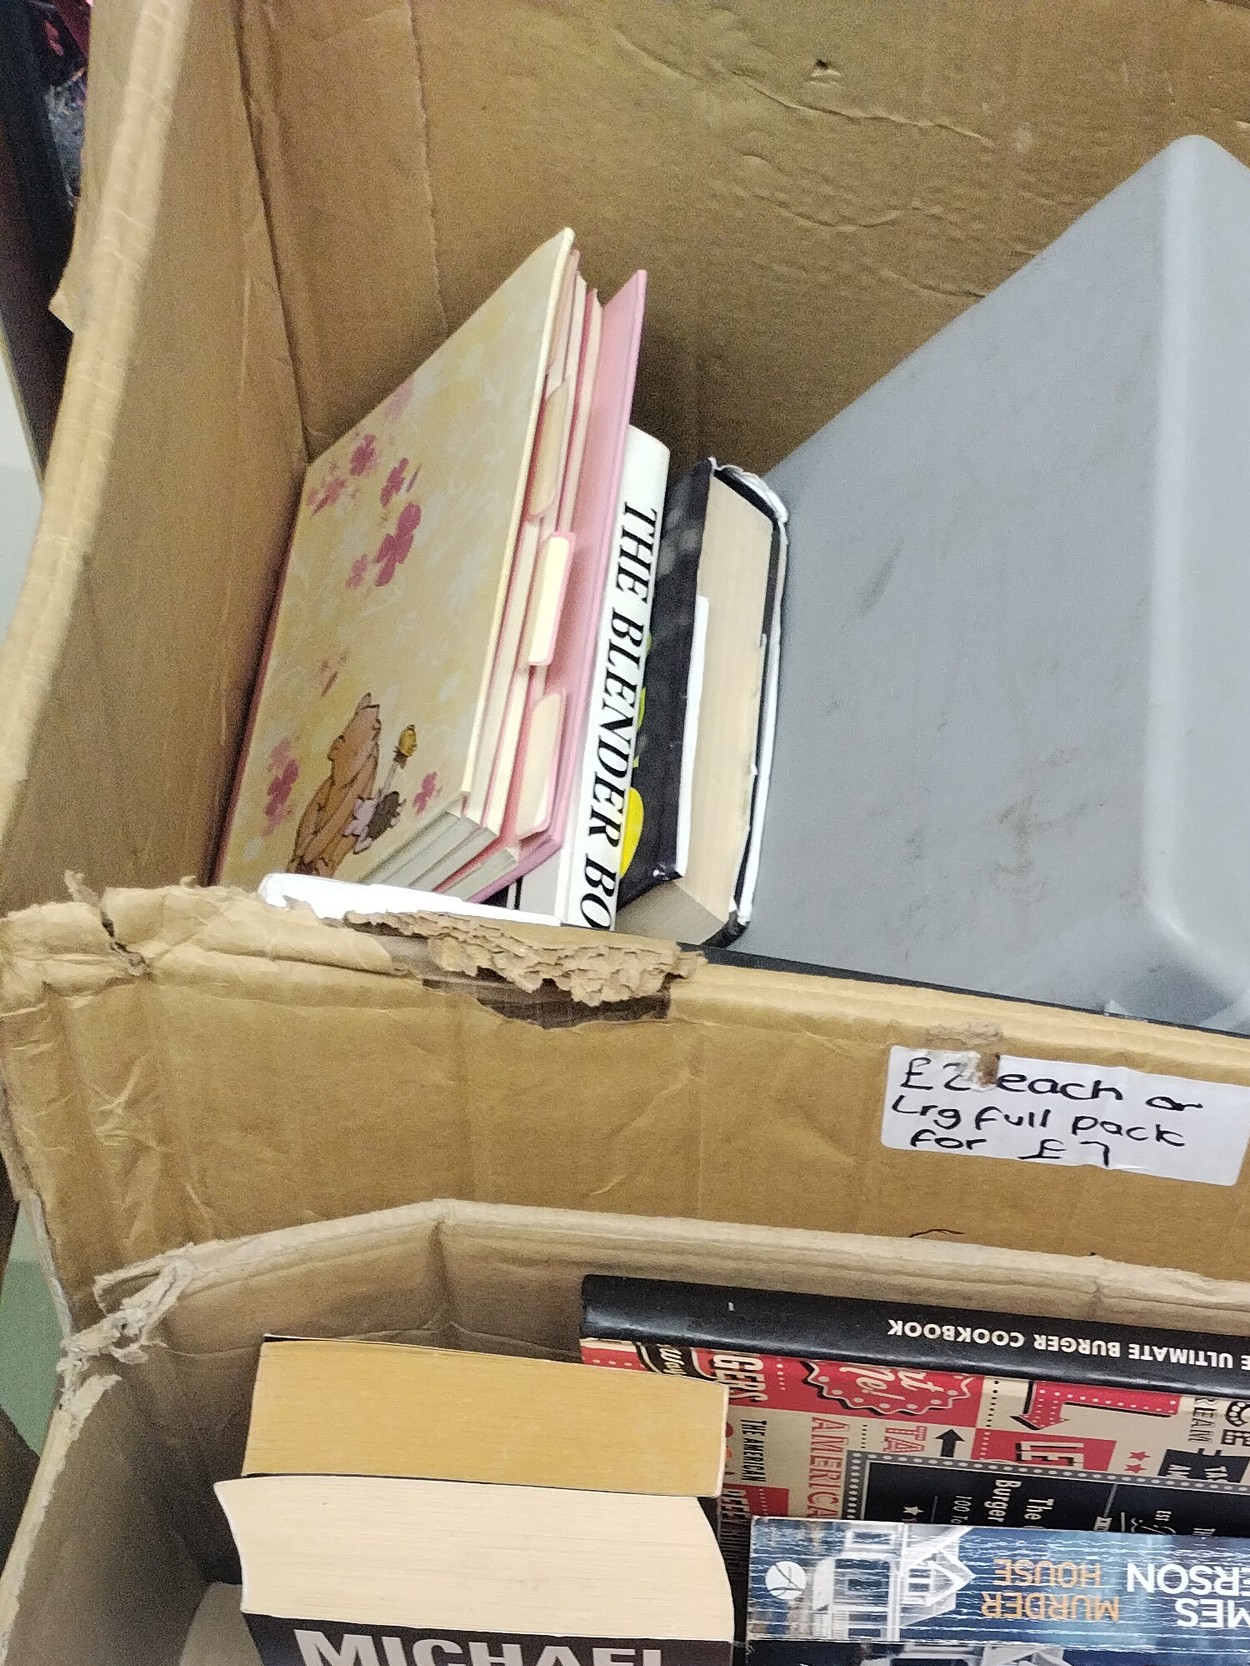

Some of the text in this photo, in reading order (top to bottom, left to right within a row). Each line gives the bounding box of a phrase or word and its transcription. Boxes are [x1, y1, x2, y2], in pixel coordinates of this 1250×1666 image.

[615, 501, 657, 600] THE
[588, 606, 646, 849] BLENDER
[995, 1072, 1125, 1102] each
[1144, 1095, 1204, 1112] or
[910, 1128, 988, 1150] for
[974, 1107, 1052, 1131] full
[1070, 1114, 1187, 1149] pack
[887, 1319, 1025, 1348] COOKBOOK
[1033, 1332, 1122, 1359] BURGER
[1128, 1343, 1234, 1370] ULTIMATE
[739, 1419, 768, 1483] THE AMERICAN
[984, 1478, 1023, 1524] Burger
[1023, 1497, 1055, 1521] The
[991, 1557, 1102, 1590] HOUSE
[980, 1590, 1121, 1623] MURDER
